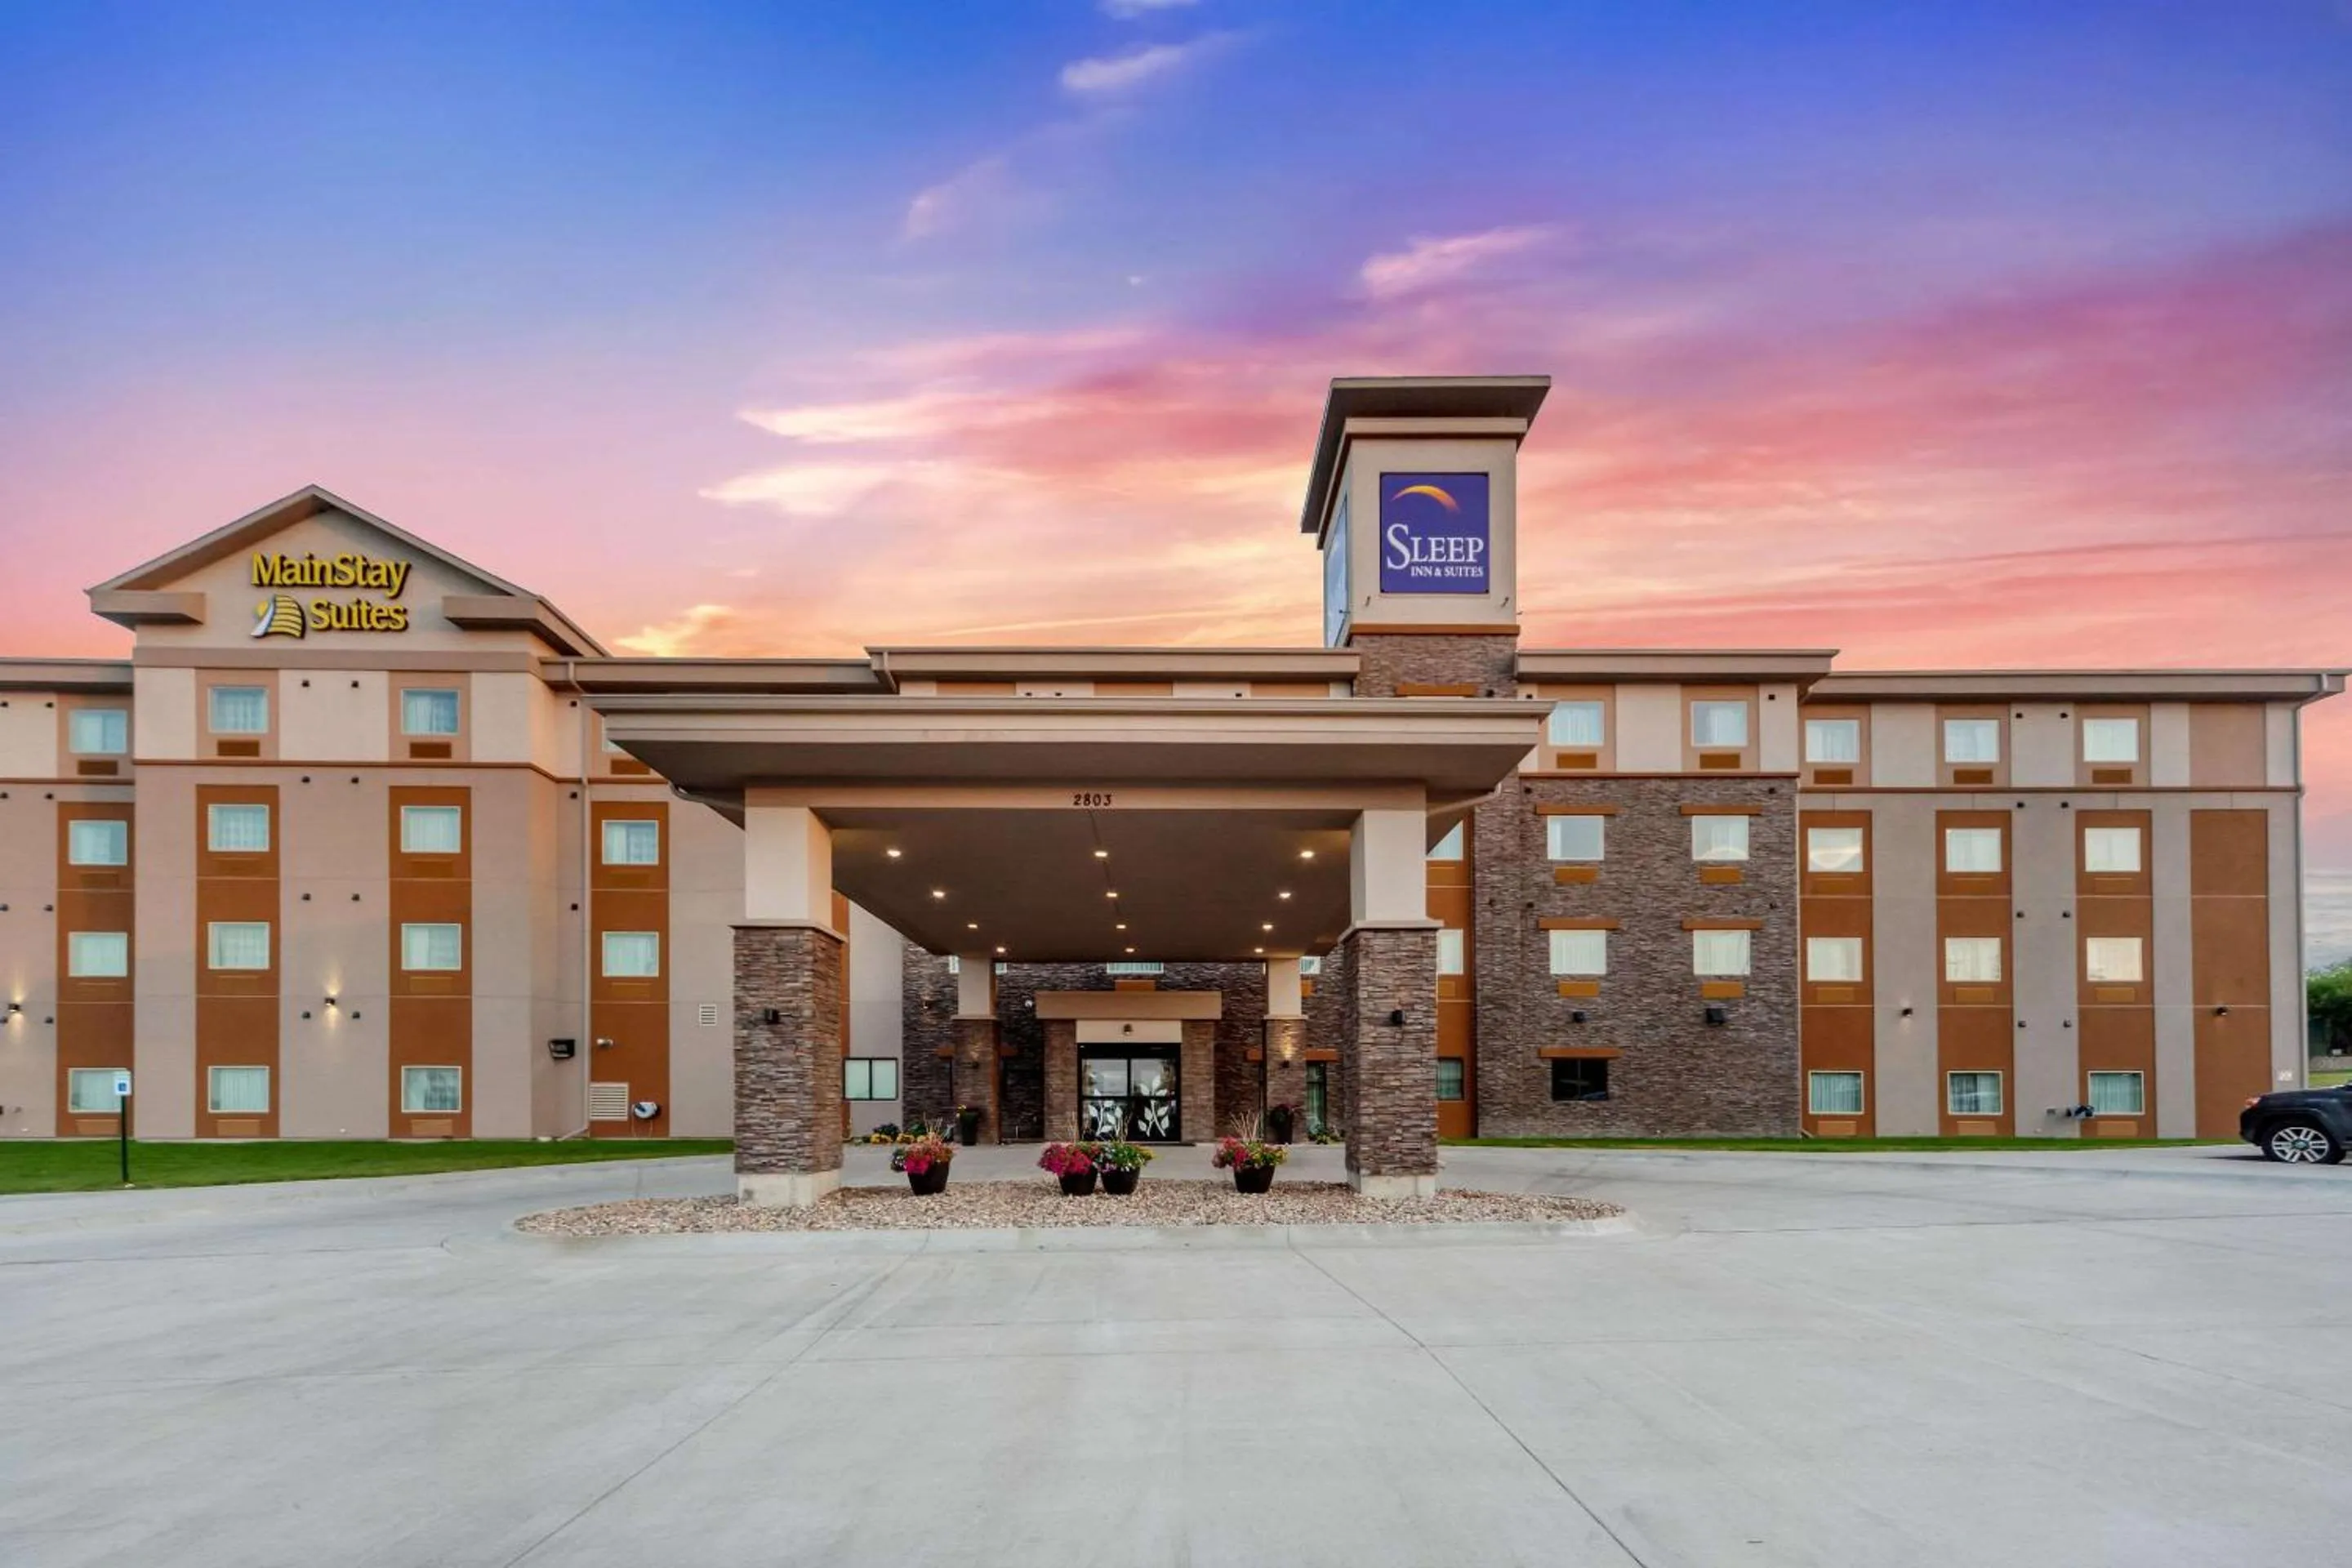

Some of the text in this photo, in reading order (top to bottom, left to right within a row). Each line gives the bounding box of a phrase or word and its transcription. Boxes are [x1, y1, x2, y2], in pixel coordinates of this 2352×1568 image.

[1387, 523, 1484, 570] SLEEP
[251, 551, 410, 598] MainStay
[1410, 565, 1484, 577] INN & SUITES
[310, 598, 408, 630] Suites
[1073, 793, 1111, 806] 2803
